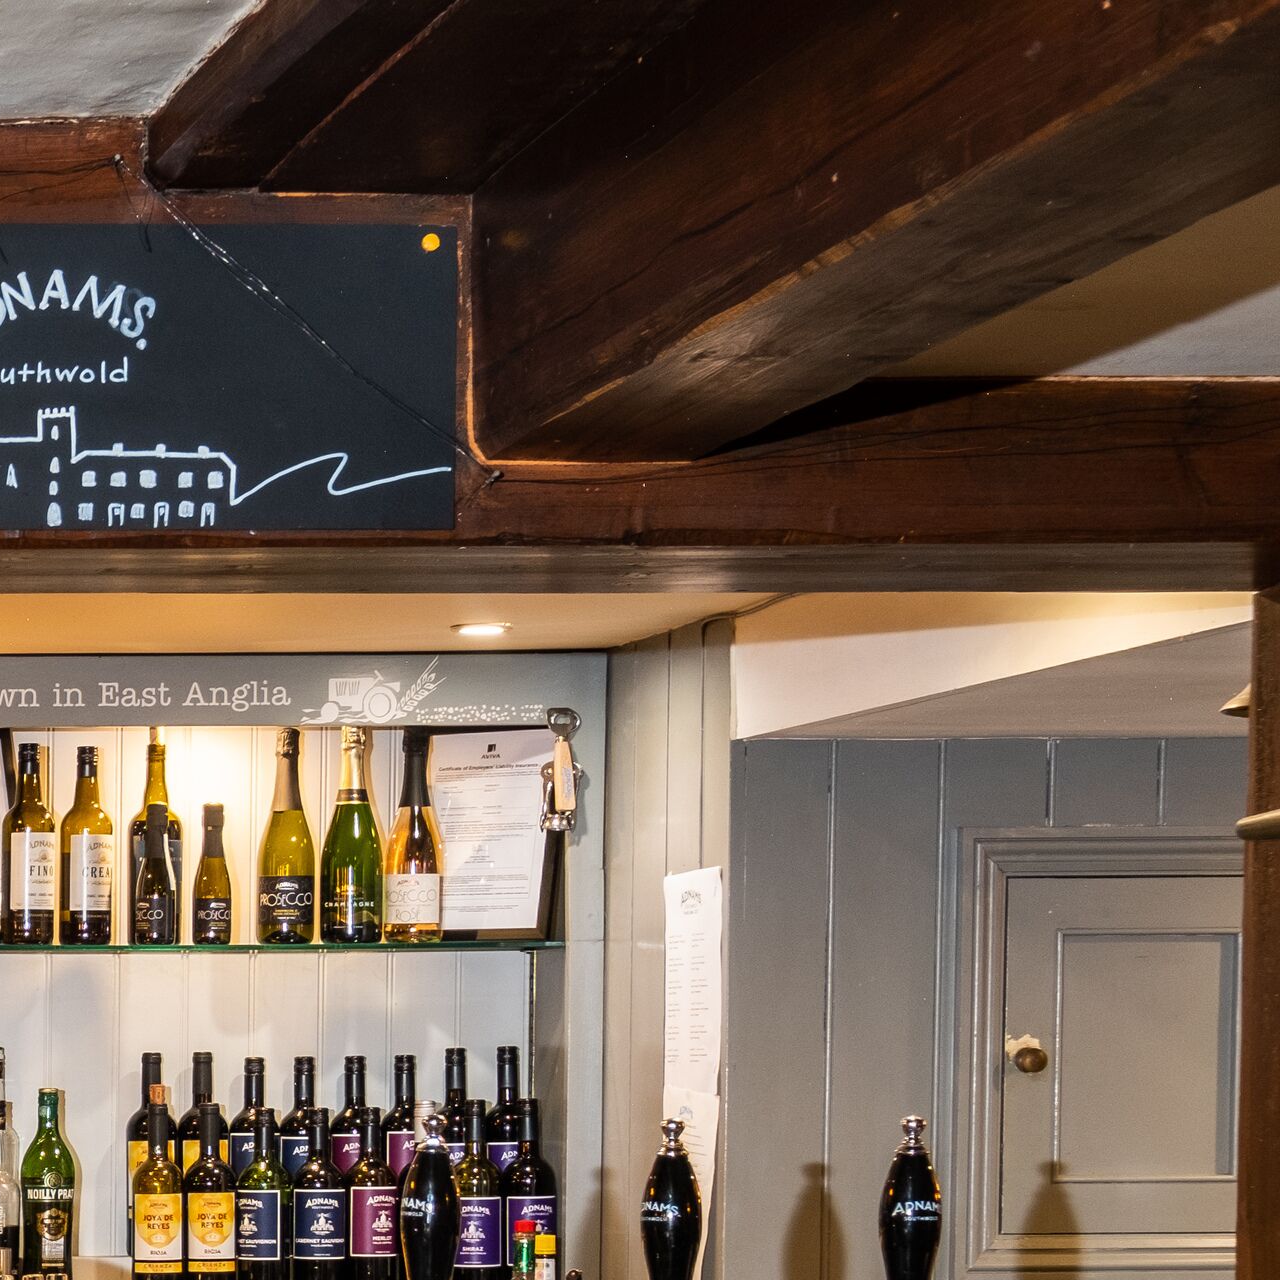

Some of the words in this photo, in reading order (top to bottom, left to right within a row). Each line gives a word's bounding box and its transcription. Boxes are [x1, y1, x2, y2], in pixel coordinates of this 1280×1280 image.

[52, 682, 86, 708] in
[97, 680, 172, 708] East
[182, 680, 292, 712] Anglia
[260, 892, 313, 907] PROSECCO
[27, 1188, 56, 1199] NOILLY
[147, 1222, 170, 1230] REYES
